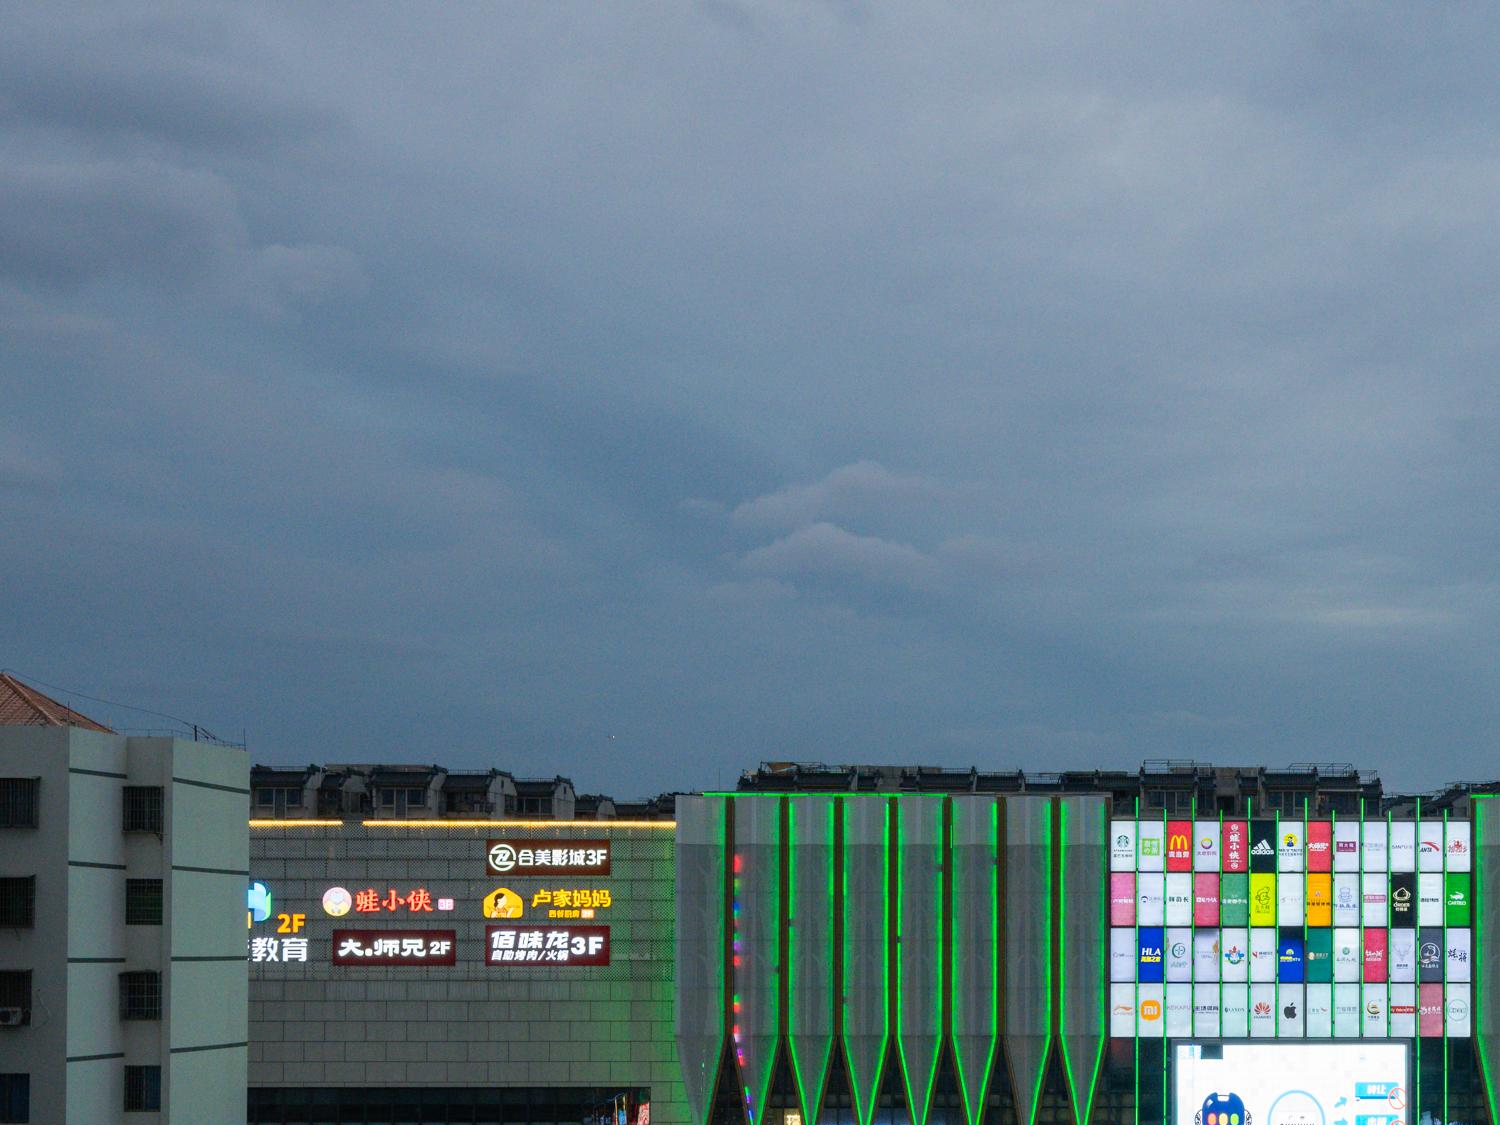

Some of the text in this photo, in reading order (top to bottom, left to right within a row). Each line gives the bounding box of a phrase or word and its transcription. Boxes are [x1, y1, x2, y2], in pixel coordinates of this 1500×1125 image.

[355, 889, 433, 913] 蛙小侠
[531, 889, 611, 908] 卢家妈妈
[277, 914, 306, 933] 2F
[248, 938, 308, 962] 教育
[570, 936, 604, 954] 3F
